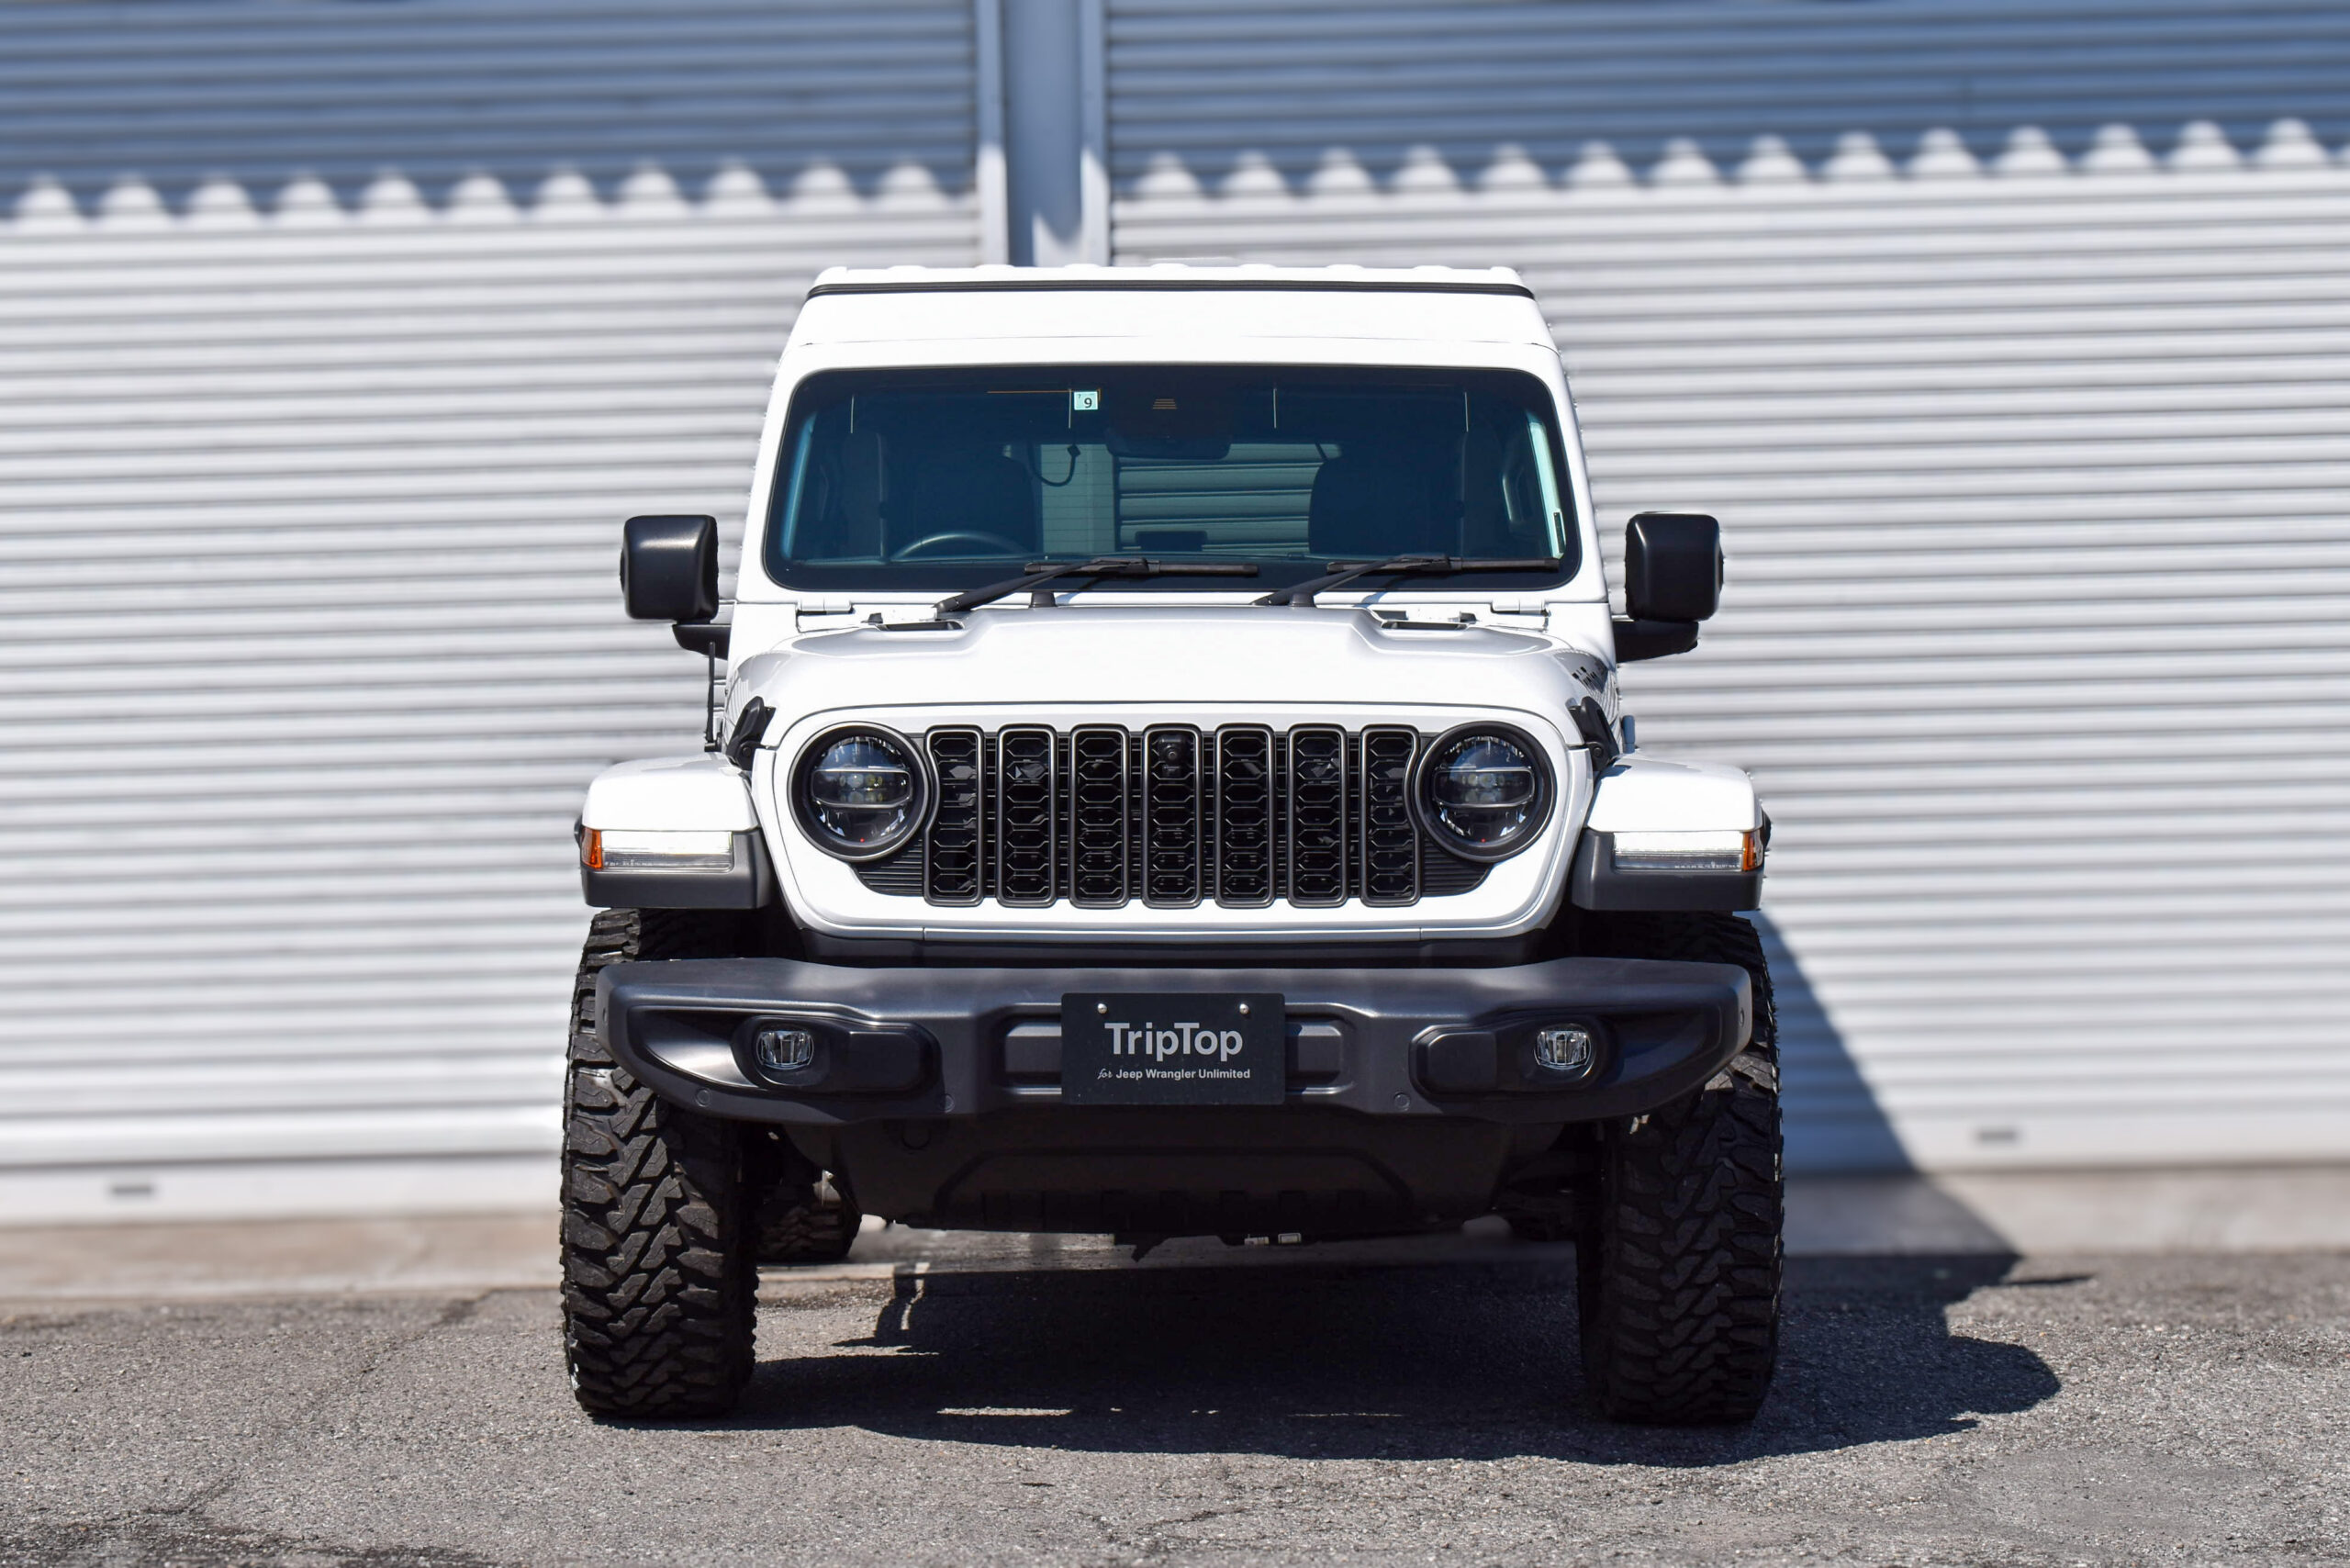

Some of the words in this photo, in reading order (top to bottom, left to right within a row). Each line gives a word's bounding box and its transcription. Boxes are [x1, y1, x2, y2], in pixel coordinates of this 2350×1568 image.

[1084, 397, 1092, 409] 9
[1104, 1022, 1243, 1062] TripTop
[1097, 1068, 1113, 1080] for
[1115, 1069, 1143, 1081] Jeep
[1145, 1069, 1196, 1081] Wrangler
[1198, 1069, 1251, 1080] Unlimited
